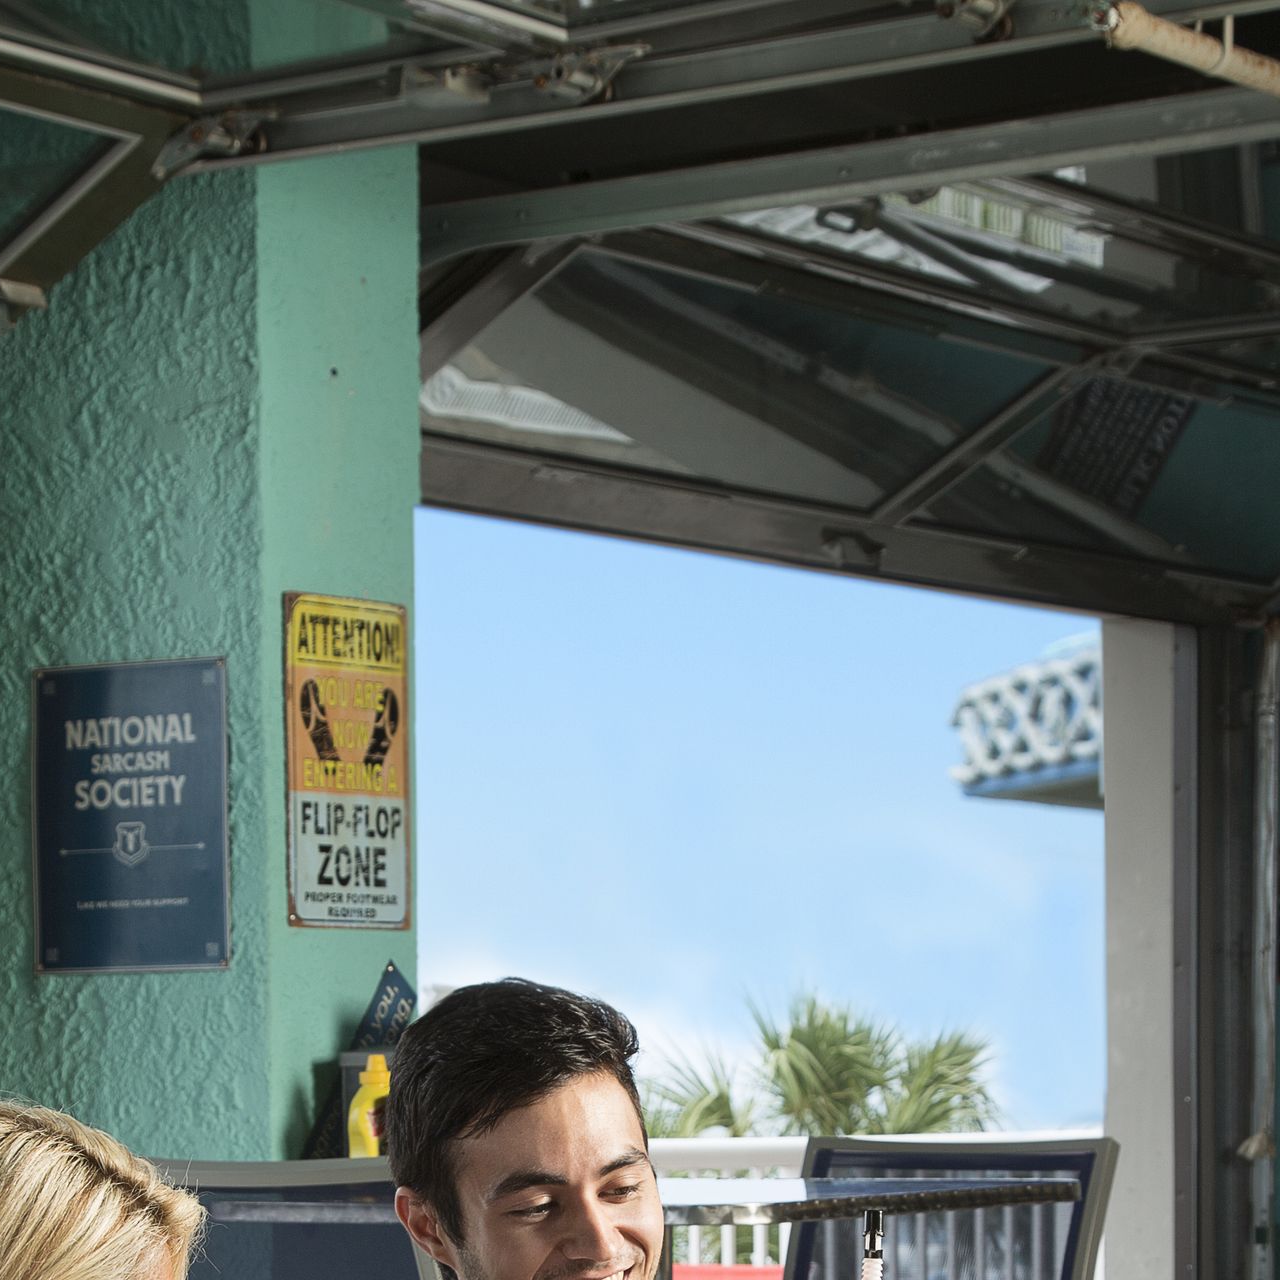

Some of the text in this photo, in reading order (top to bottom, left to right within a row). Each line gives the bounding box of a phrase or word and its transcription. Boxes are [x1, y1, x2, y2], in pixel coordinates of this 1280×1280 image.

[298, 612, 401, 664] ATTENTION!
[317, 675, 384, 712] YOU ARE
[64, 713, 197, 749] NATIONAL
[333, 719, 370, 750] NOW
[90, 750, 170, 774] SARCASM
[303, 758, 399, 793] ENTERING A
[74, 774, 187, 811] SOCIETY
[301, 801, 402, 839] FLIP-FLOP
[317, 844, 387, 888] ZONE
[304, 891, 398, 905] PROPER FOOTWEAR
[327, 907, 377, 919] REQUIRED
